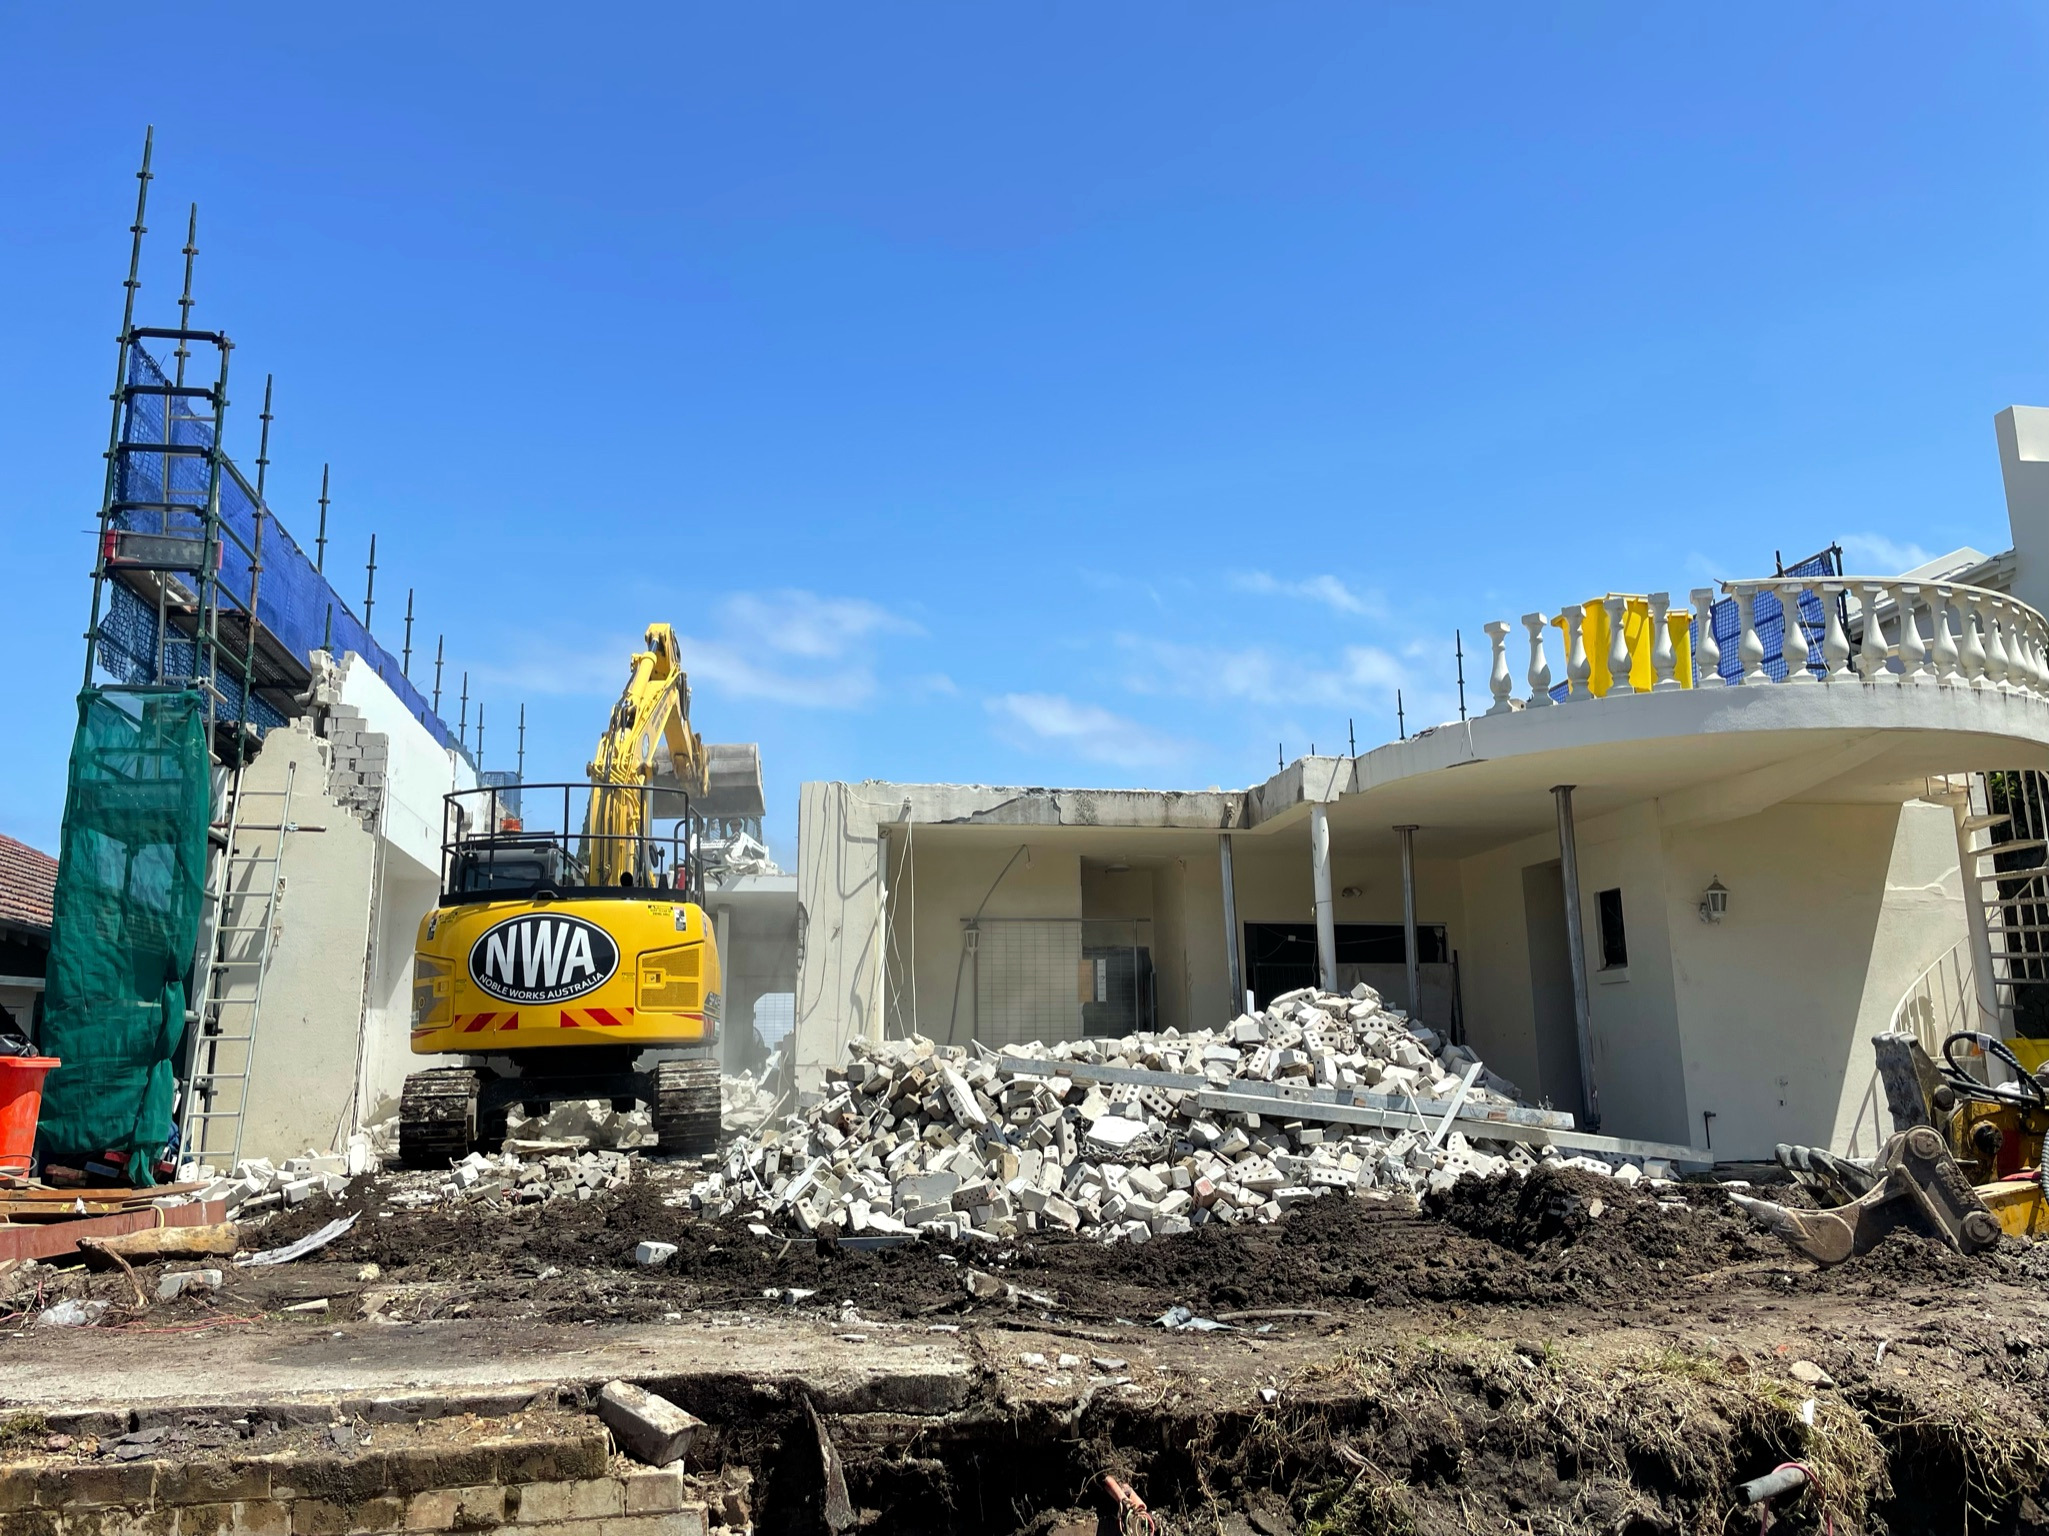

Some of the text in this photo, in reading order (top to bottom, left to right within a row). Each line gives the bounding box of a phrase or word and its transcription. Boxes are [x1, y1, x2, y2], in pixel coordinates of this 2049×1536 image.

[485, 920, 596, 988] NWA
[479, 973, 508, 995] NOBLE
[509, 988, 545, 1000] WORKS
[547, 972, 604, 999] AUSTRALIA
